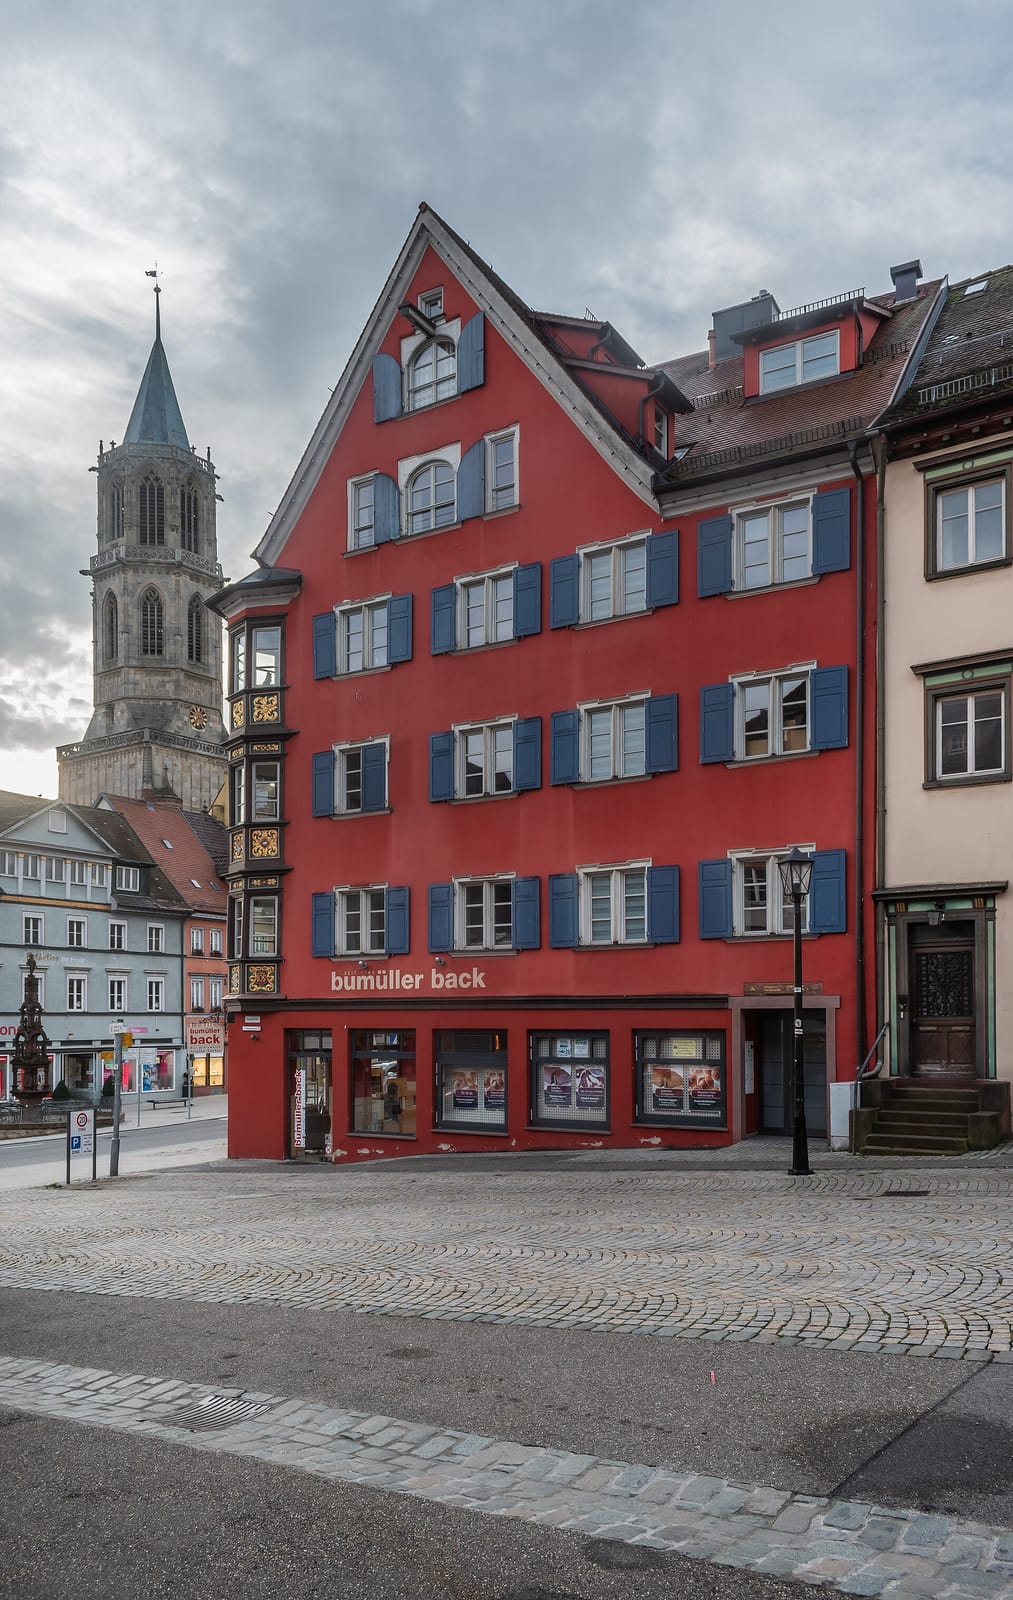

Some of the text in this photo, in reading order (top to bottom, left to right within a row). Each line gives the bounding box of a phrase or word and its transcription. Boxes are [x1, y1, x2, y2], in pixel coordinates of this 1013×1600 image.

[331, 967, 487, 991] bumüller back
[190, 1034, 220, 1045] back
[73, 1137, 79, 1148] P
